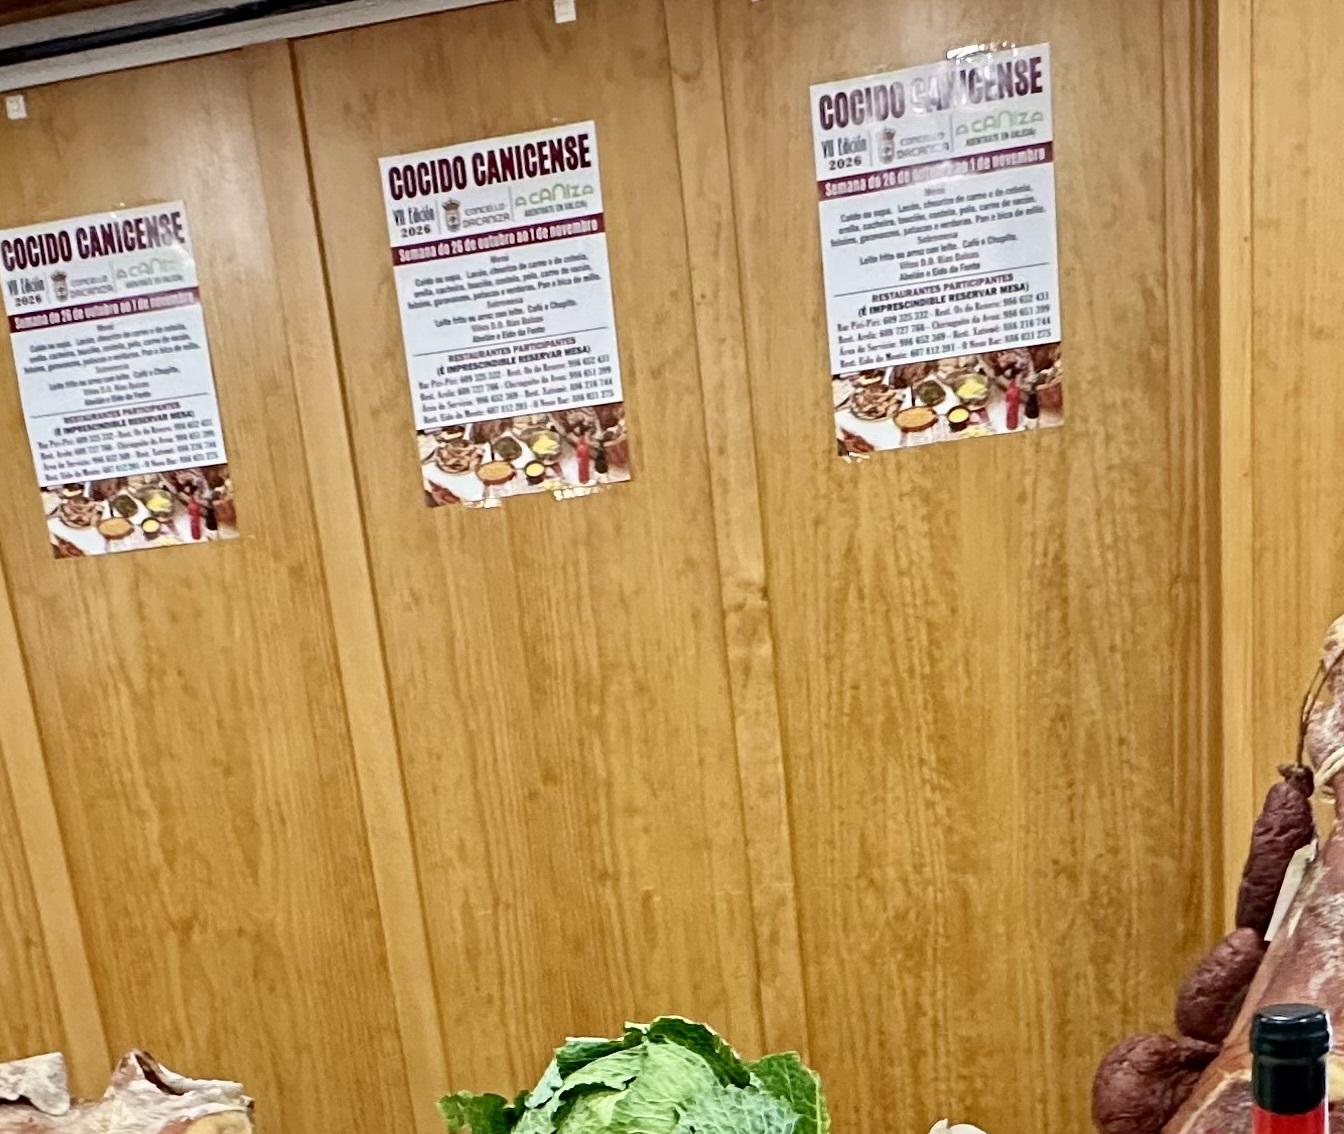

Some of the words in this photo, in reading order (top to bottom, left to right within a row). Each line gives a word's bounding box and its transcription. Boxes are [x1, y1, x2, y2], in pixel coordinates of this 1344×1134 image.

[818, 80, 905, 130] COCIDO
[387, 154, 468, 201] COCIDO
[471, 132, 591, 187] CANICENSE
[828, 156, 861, 170] 2026
[0, 229, 73, 271] COCIDO
[74, 211, 185, 259] CANICENSE
[400, 224, 430, 238] 2026
[398, 243, 436, 263] Semana
